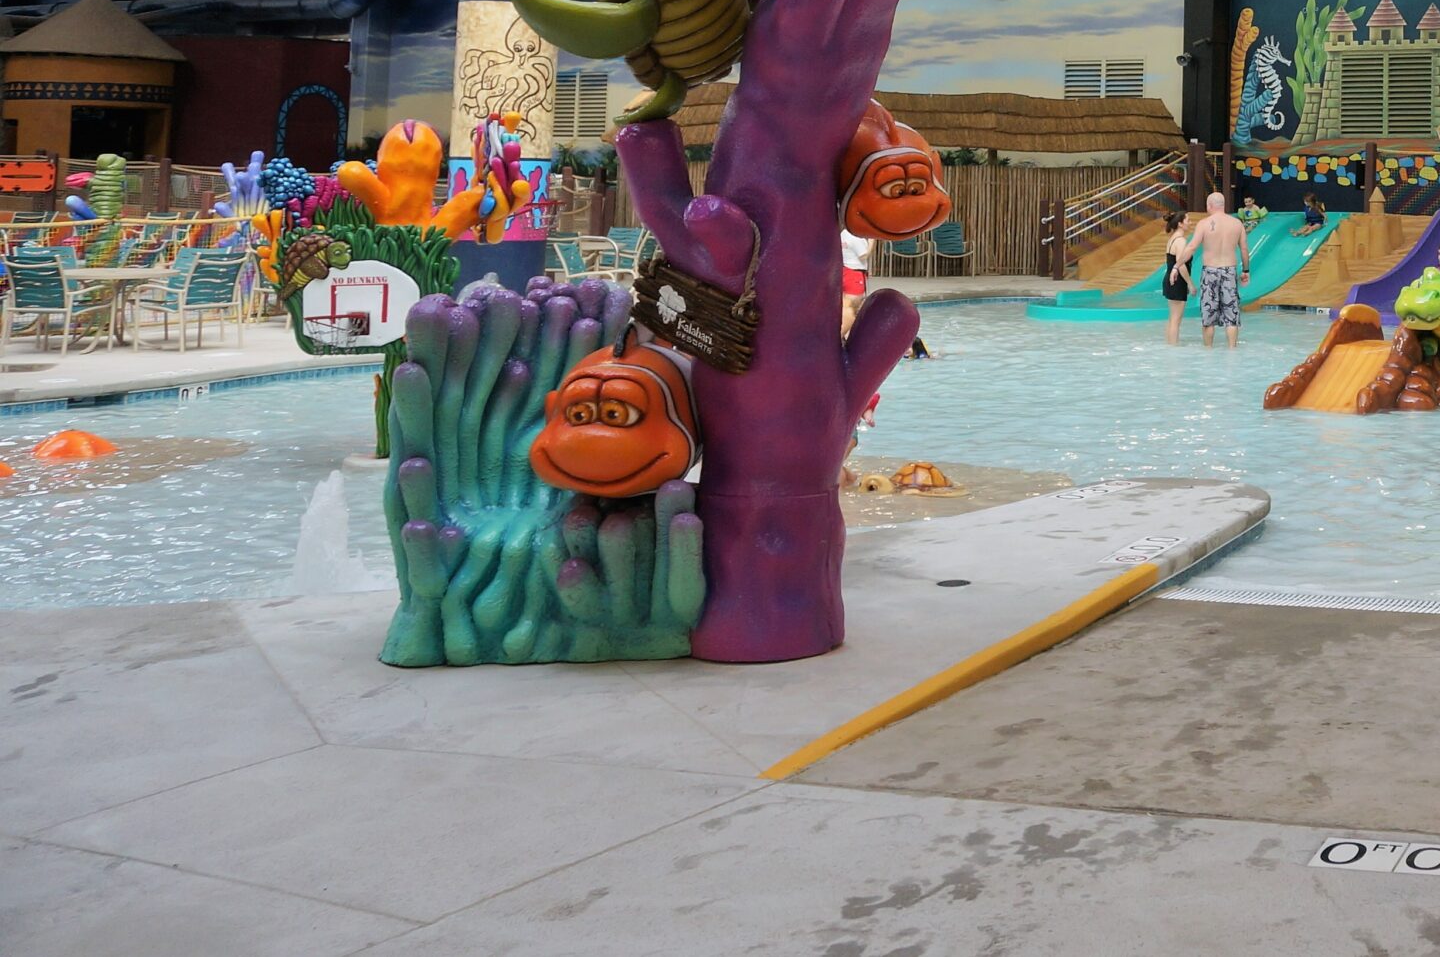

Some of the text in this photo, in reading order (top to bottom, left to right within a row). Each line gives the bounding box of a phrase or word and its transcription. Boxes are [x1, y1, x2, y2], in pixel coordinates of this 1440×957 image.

[347, 276, 388, 284] DUNKING
[677, 318, 713, 345] Kalahari
[1319, 841, 1368, 865] 0
[1372, 843, 1403, 853] FT
